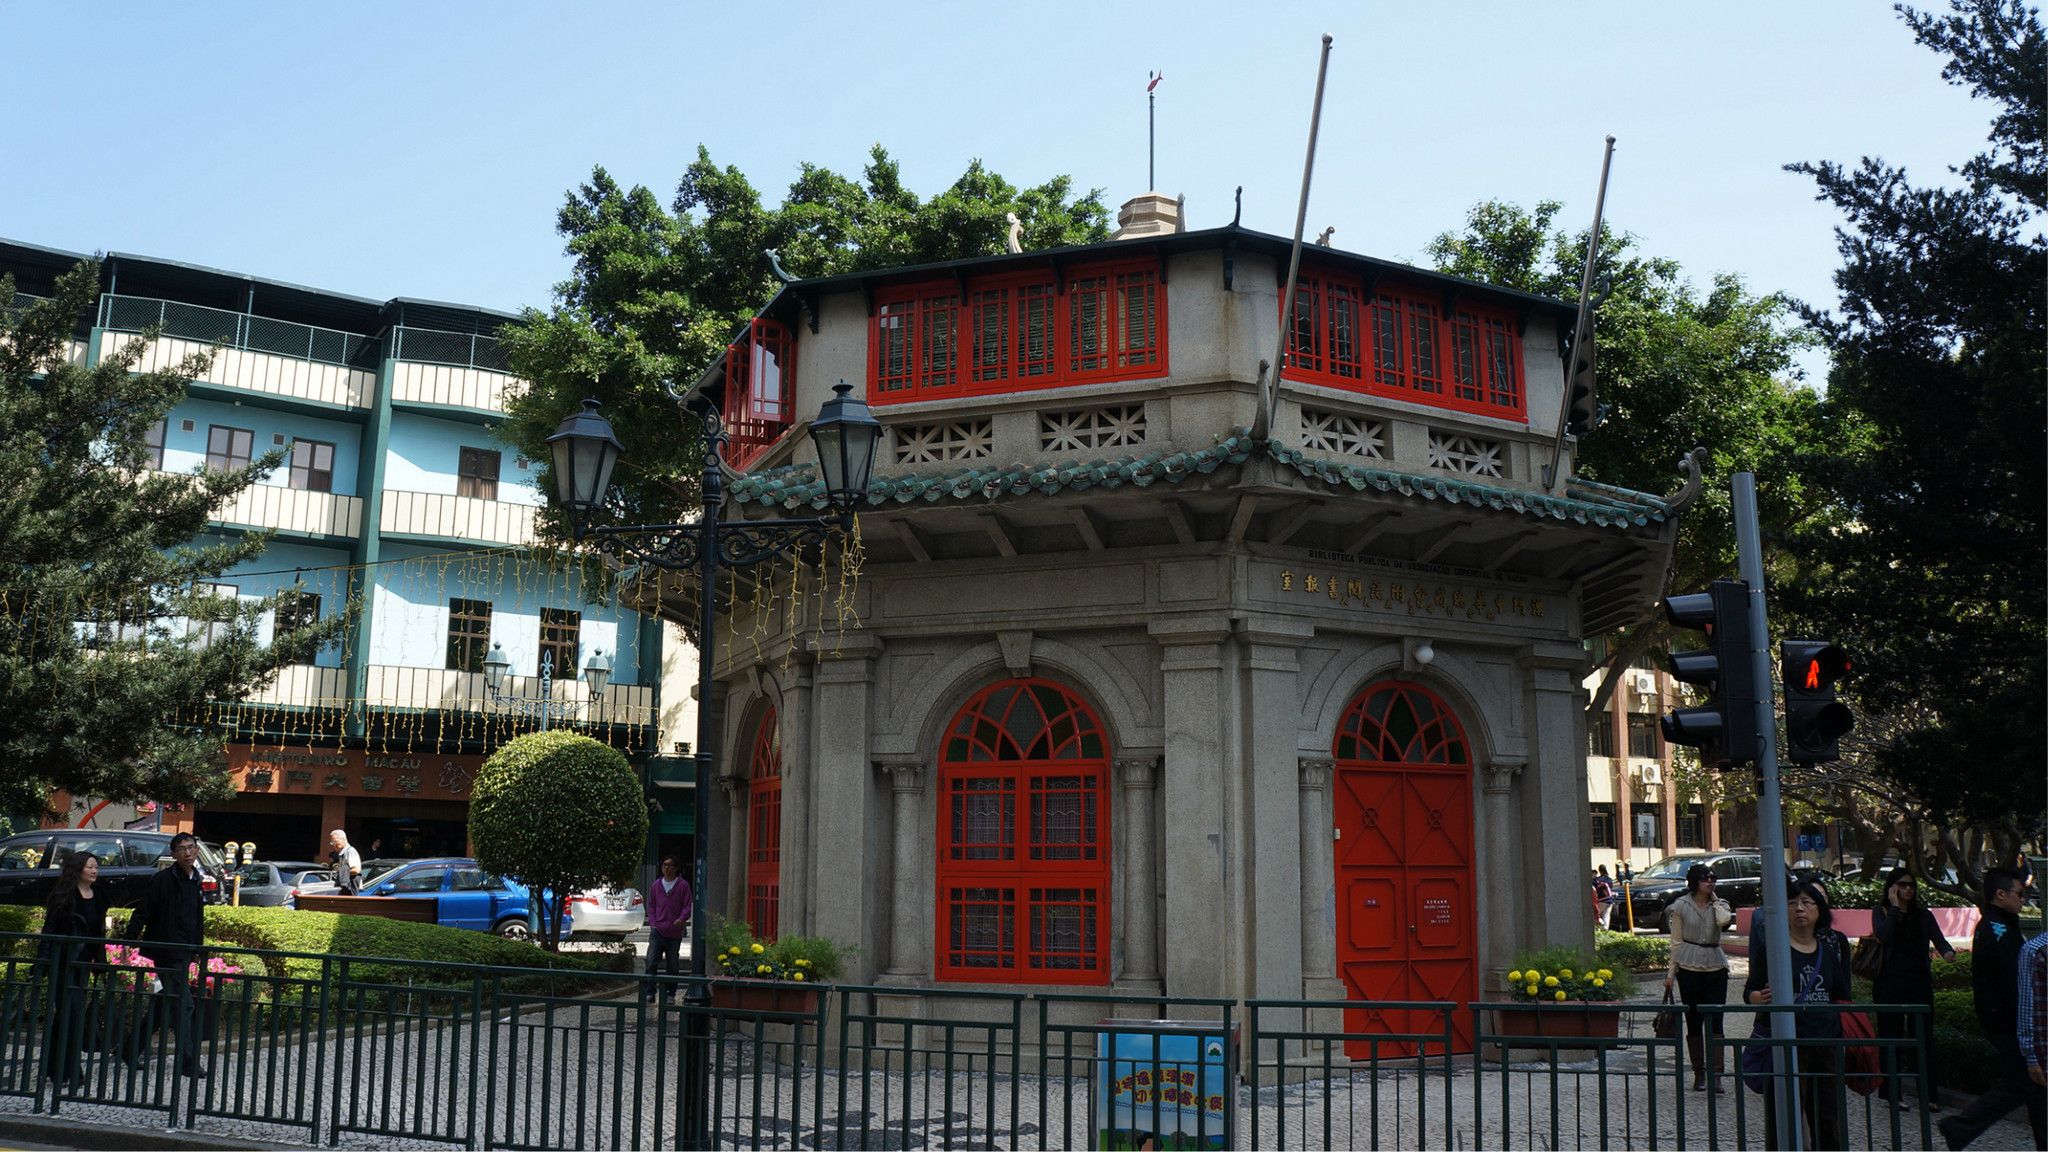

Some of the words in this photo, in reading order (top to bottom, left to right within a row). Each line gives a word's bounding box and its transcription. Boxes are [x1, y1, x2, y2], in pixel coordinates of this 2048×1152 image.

[1308, 549, 1354, 563] BIBLIOTECA
[1359, 556, 1390, 567] PUBLICA
[251, 751, 348, 767] CINETEATRO
[365, 756, 422, 770] MACAU
[250, 769, 423, 792] 澳門大會堂
[1800, 834, 1807, 845] P
[1815, 836, 1822, 847] P
[1793, 991, 1830, 1002] PNCESS
